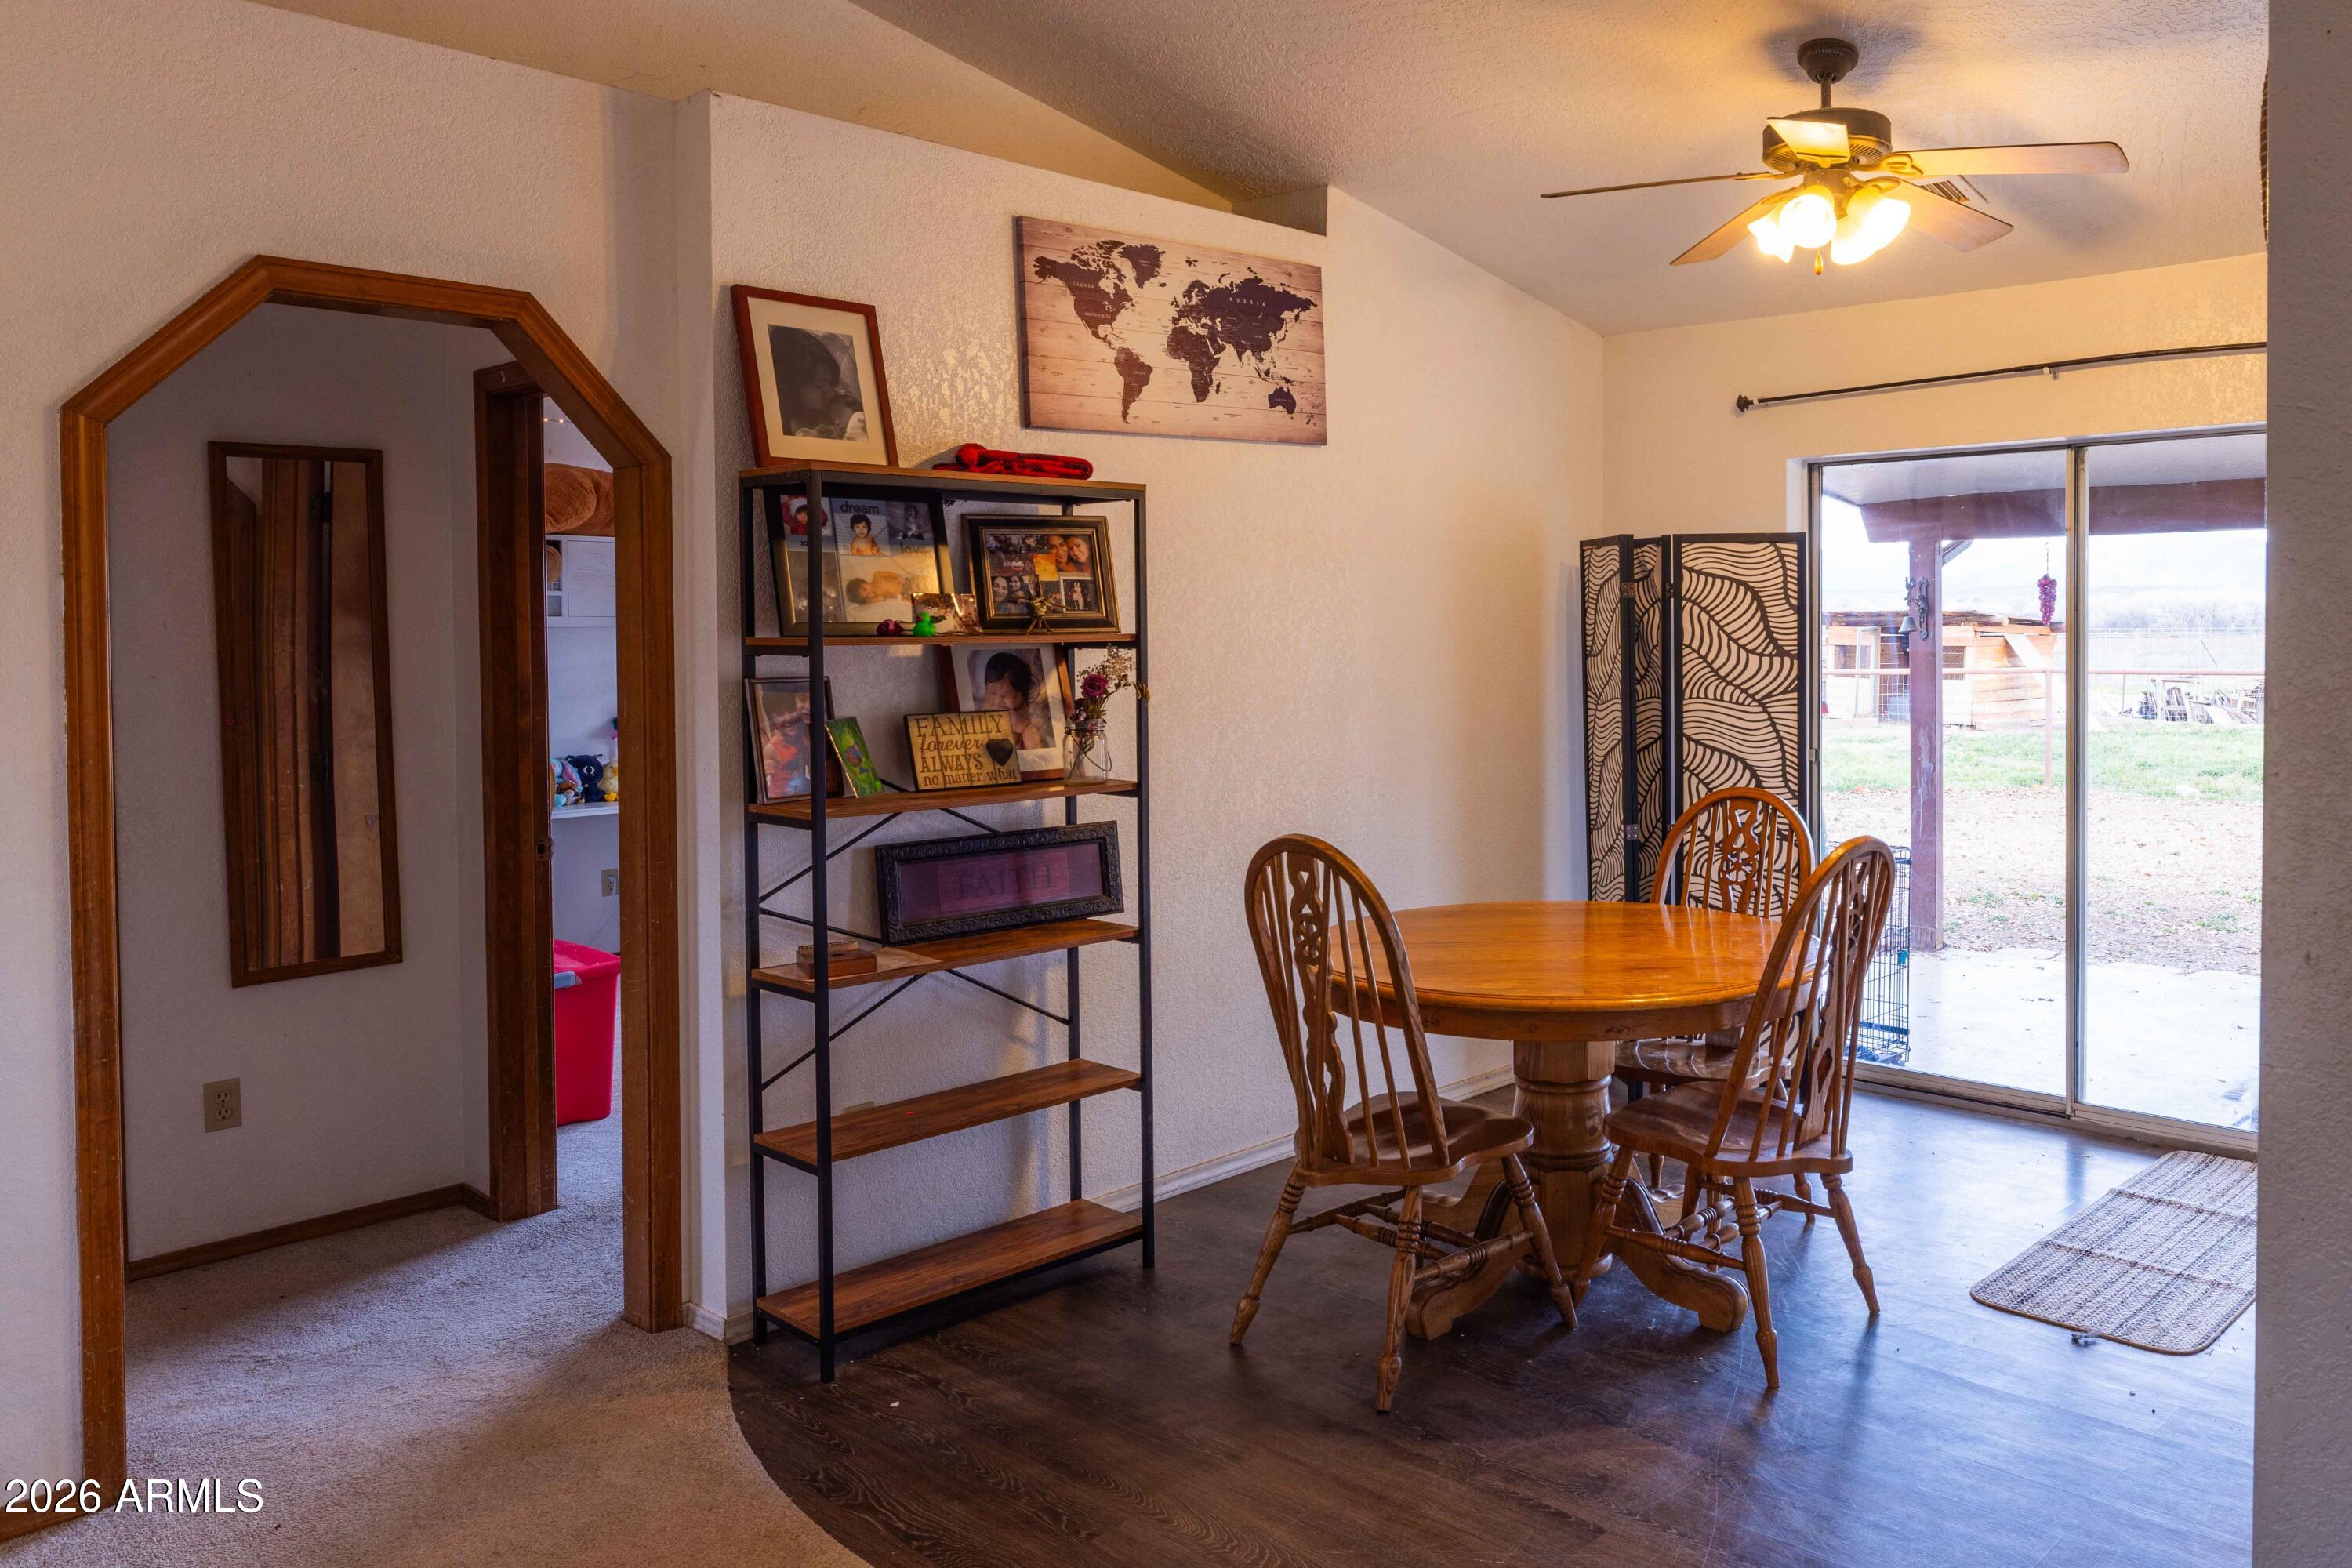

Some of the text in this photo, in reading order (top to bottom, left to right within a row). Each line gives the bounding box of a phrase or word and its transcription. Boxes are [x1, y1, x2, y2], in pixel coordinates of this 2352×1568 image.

[1229, 296, 1265, 307] RUSSIA
[840, 499, 880, 514] dream
[914, 714, 1003, 738] FAMILY
[920, 732, 984, 758] forever
[920, 753, 984, 773] ALWAYS
[924, 768, 1017, 786] no matter what
[956, 863, 1054, 901] FAITH
